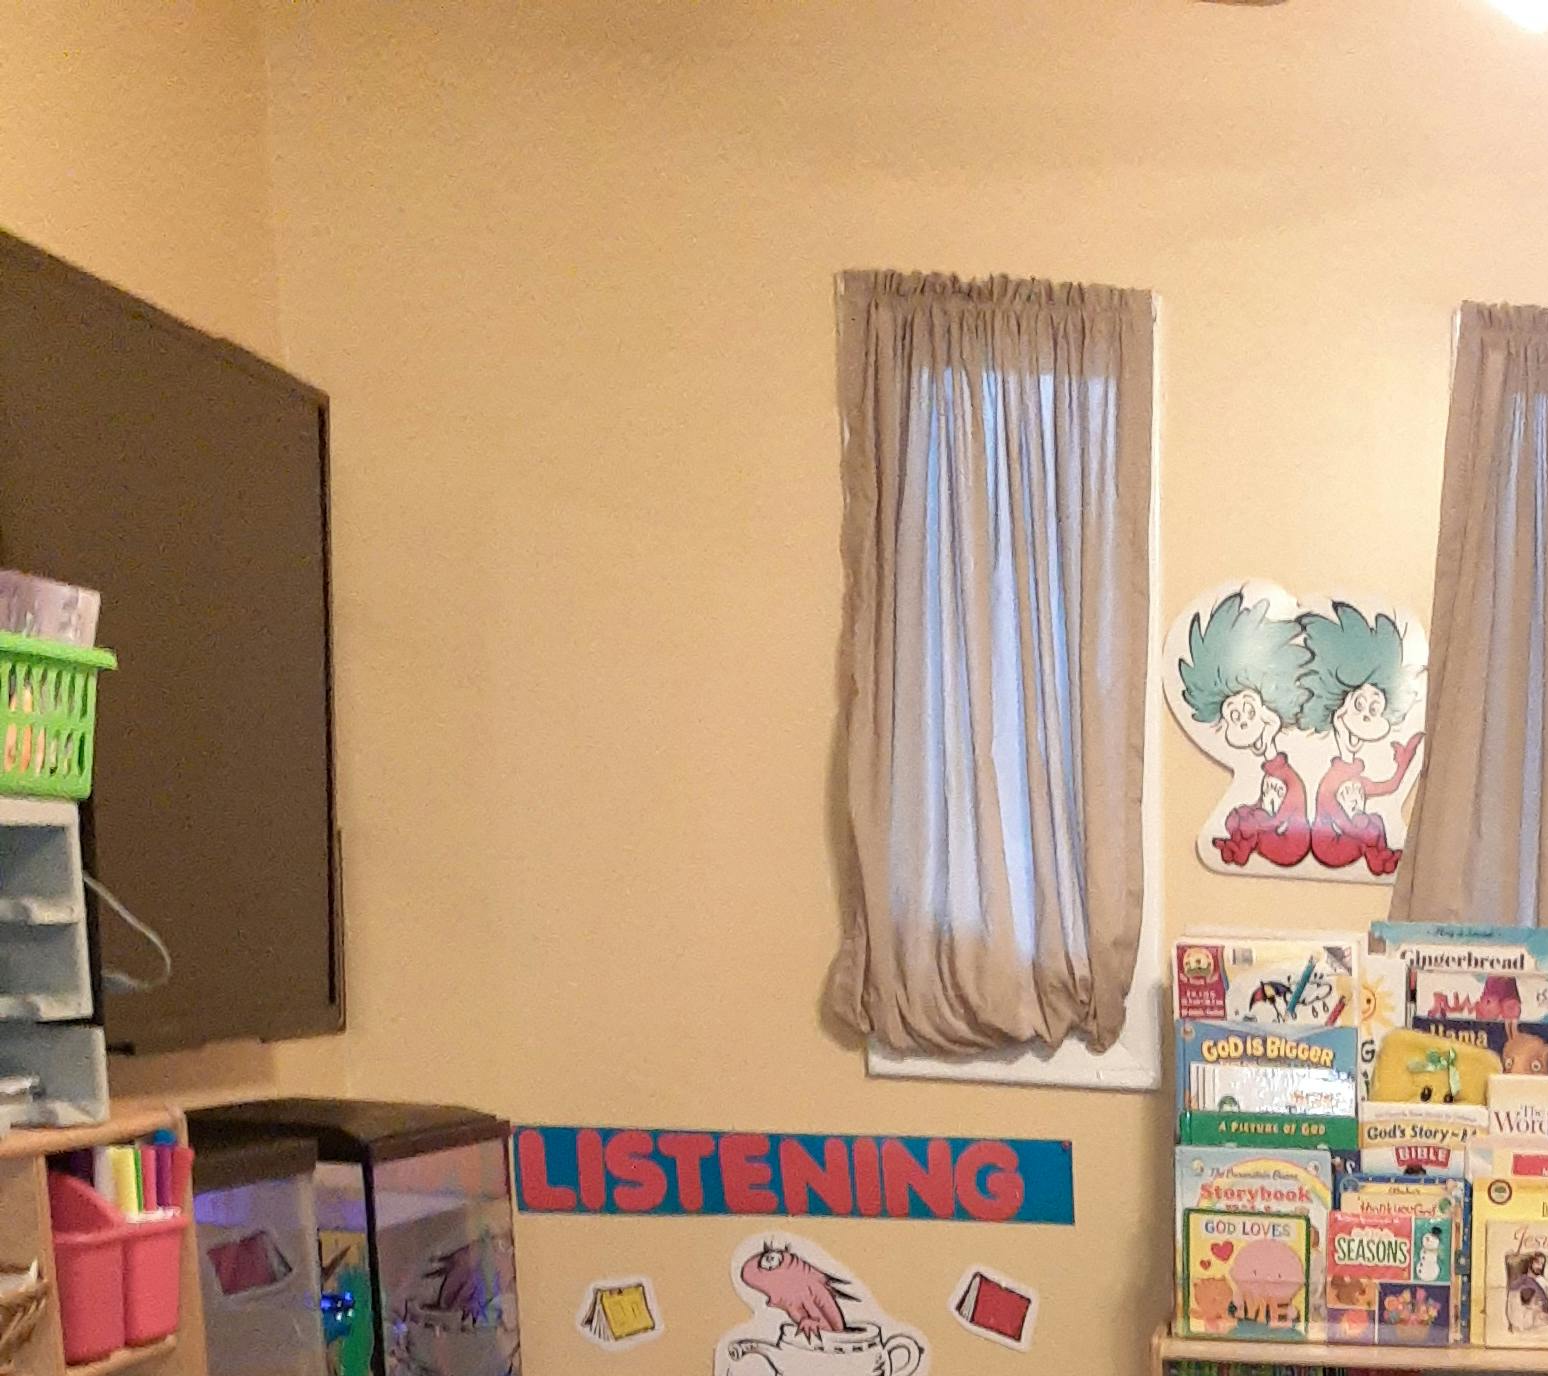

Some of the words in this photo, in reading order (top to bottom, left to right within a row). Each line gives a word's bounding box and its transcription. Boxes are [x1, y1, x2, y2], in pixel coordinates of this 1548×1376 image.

[1410, 1125, 1452, 1142] Story
[1399, 1146, 1447, 1162] BIBLE
[517, 1129, 1025, 1222] LISTENING
[1200, 1183, 1312, 1202] Storybook
[1204, 1220, 1236, 1236] GOD
[1242, 1221, 1291, 1237] LOVES
[1336, 1236, 1408, 1265] SEASONS
